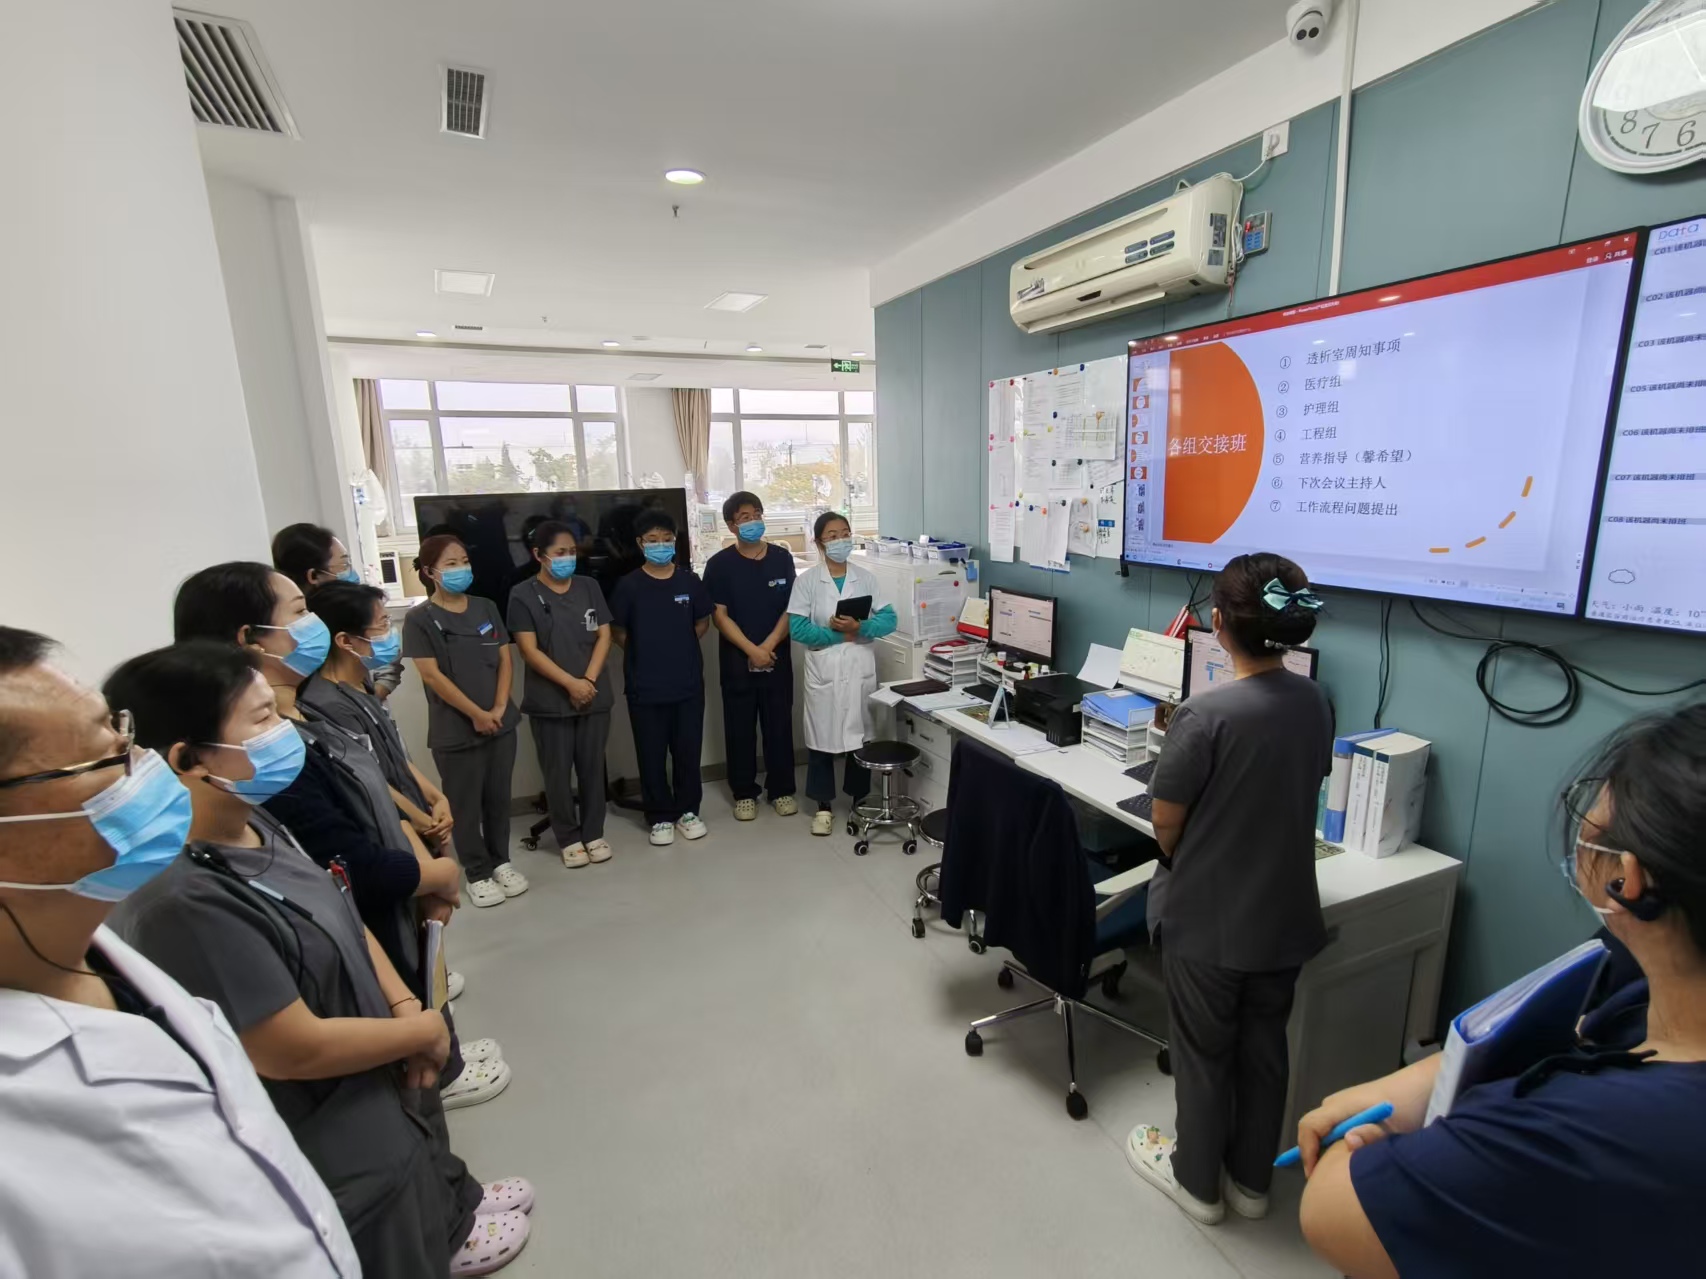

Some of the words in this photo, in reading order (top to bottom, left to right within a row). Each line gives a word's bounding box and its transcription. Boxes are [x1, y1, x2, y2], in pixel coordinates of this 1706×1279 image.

[1620, 110, 1638, 134] 8
[1641, 122, 1660, 149] 7
[1676, 120, 1696, 147] 6
[1674, 240, 1706, 251] 该机器
[1645, 293, 1663, 302] C02
[1637, 339, 1655, 348] C03
[1306, 338, 1400, 365] 透析室周知事项
[1304, 375, 1342, 391] 医疗组
[1303, 400, 1340, 416] 护理组
[1301, 426, 1338, 441] 工程组
[1622, 429, 1639, 437] C06
[1168, 433, 1248, 457] 各组交接班
[1299, 476, 1387, 490] 下次会议主持人
[1614, 474, 1631, 482] C07
[1297, 501, 1398, 516] 工作流程问题提出
